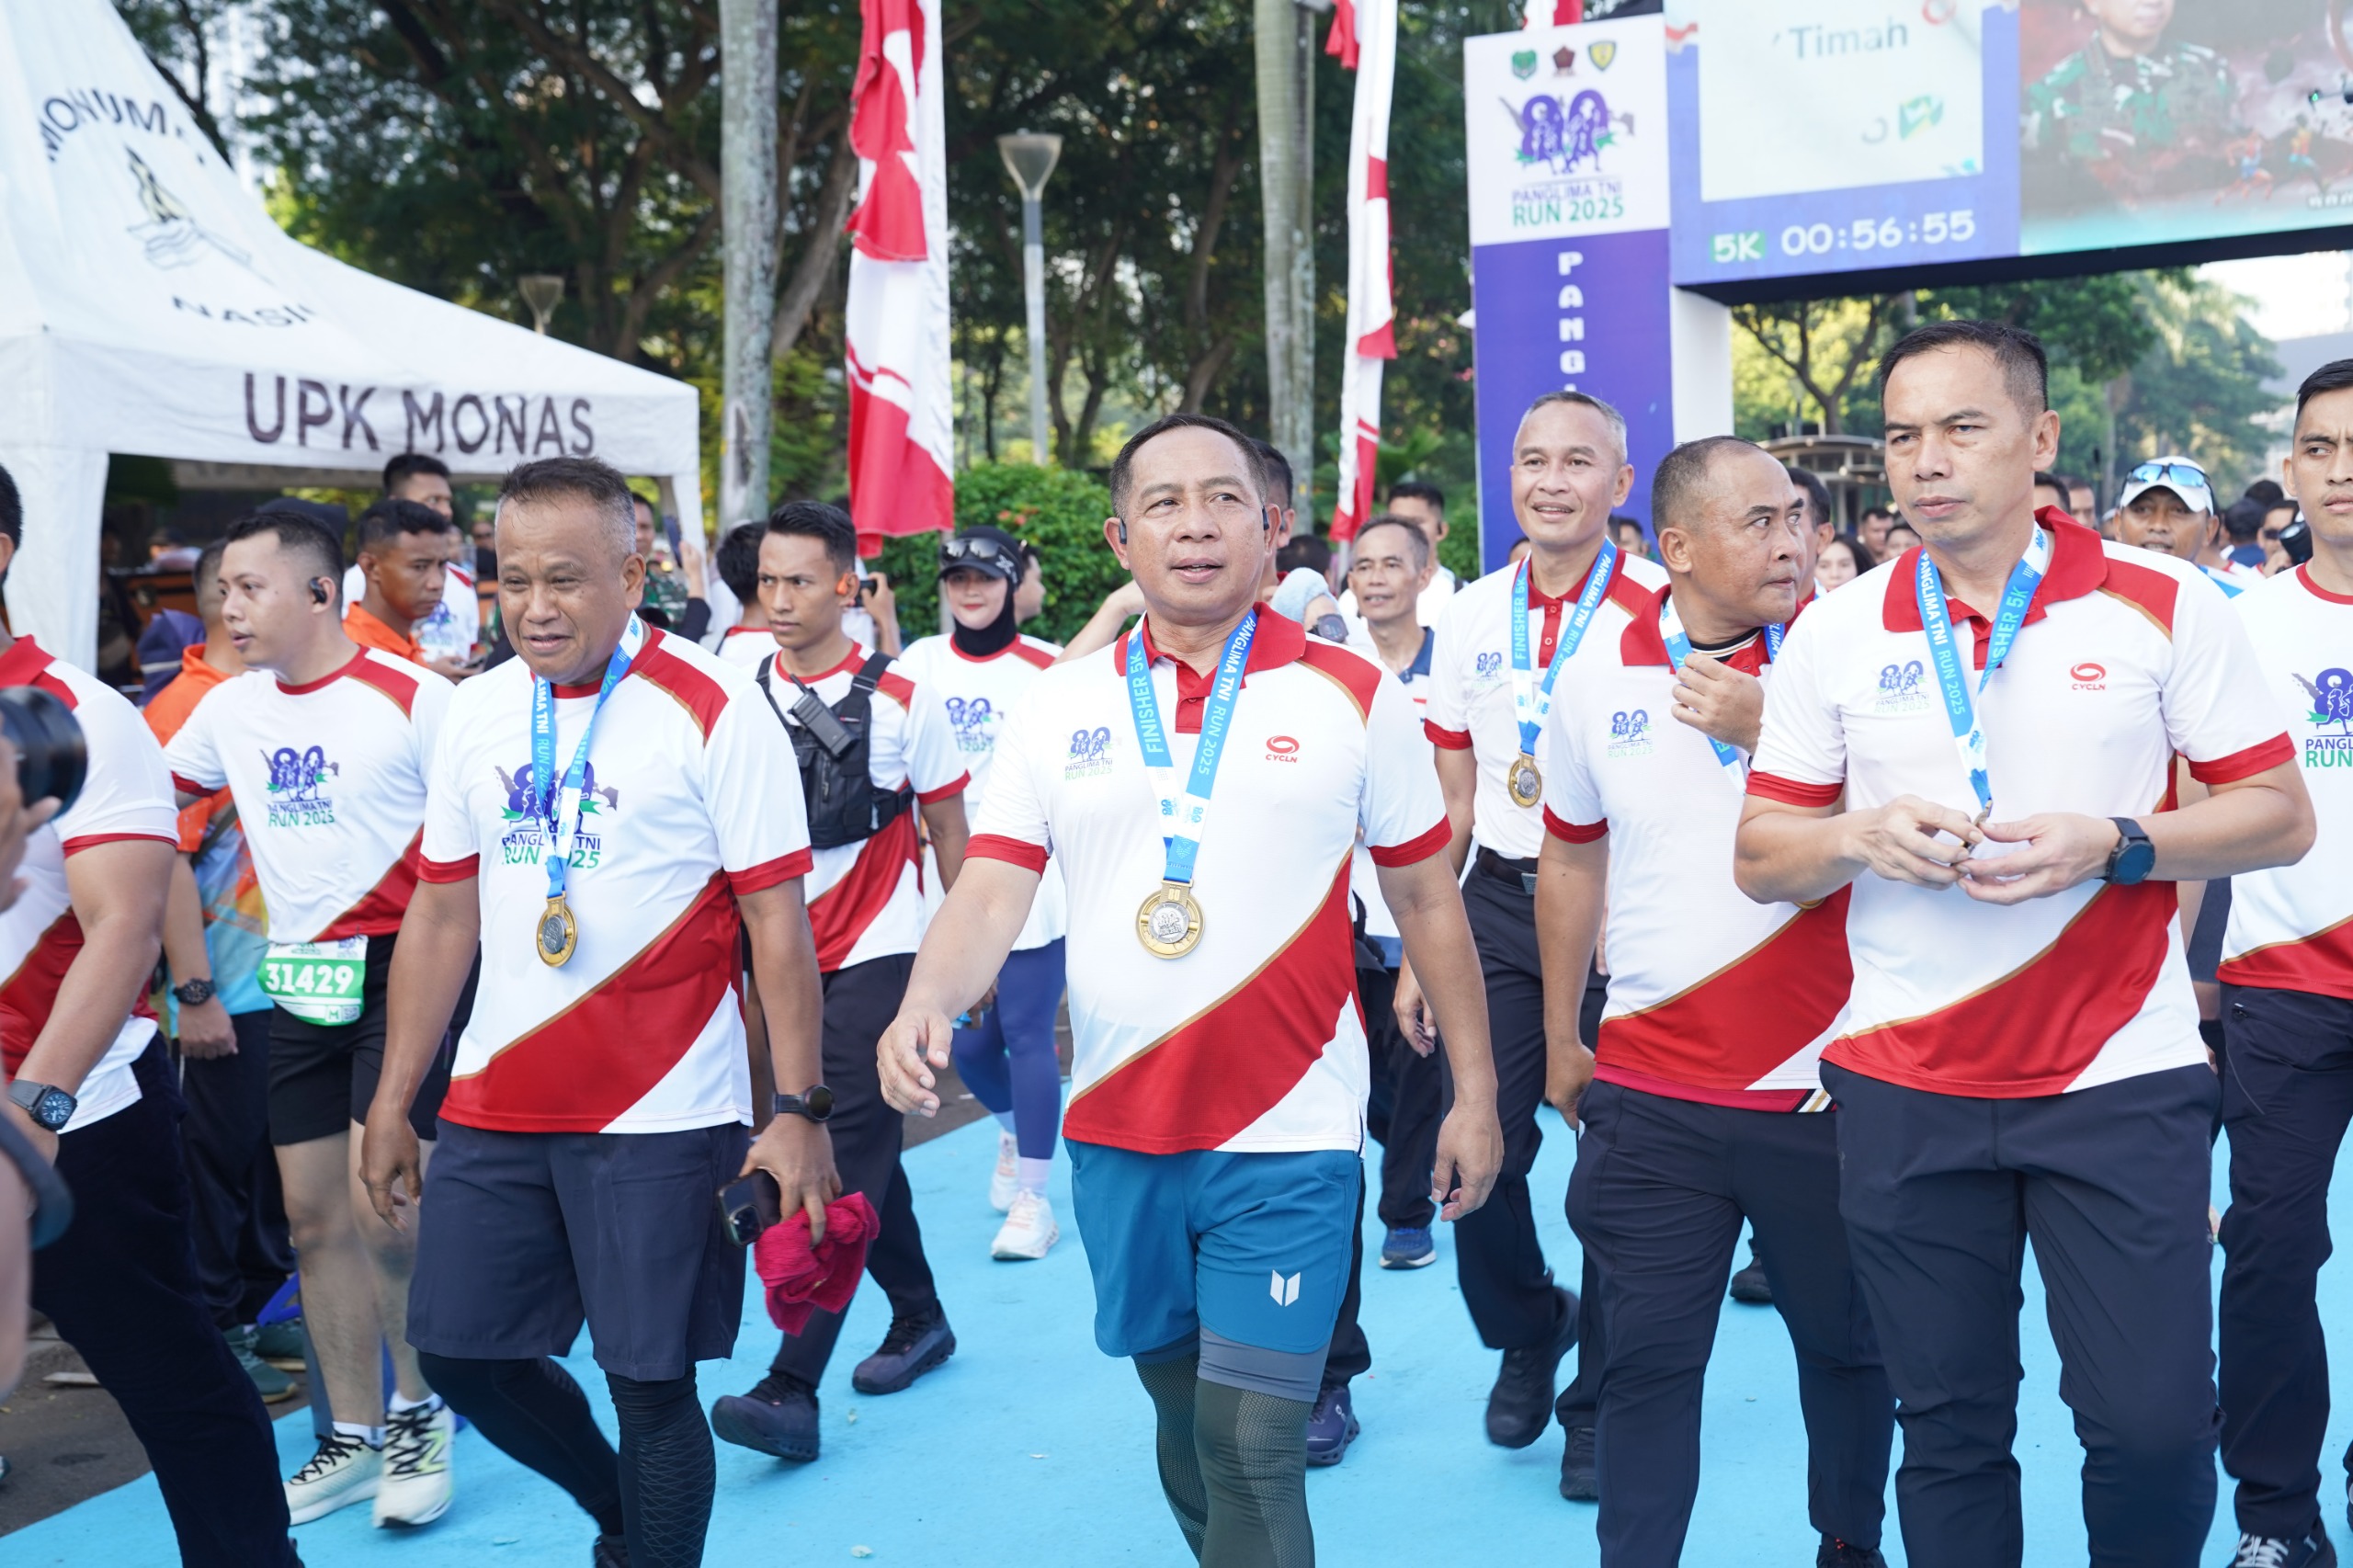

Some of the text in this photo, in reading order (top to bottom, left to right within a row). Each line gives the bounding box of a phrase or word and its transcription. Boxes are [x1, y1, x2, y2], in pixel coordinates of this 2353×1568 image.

[1789, 16, 1909, 59] Timah
[1512, 180, 1622, 203] PANGLIMA TNI
[1513, 195, 1624, 227] RUN 2025
[1713, 210, 1976, 263] 5K 00:56:55
[171, 294, 317, 327] NASI
[1558, 251, 1586, 392] PANG
[244, 371, 595, 457] UPK MONAS
[1583, 553, 1612, 609] PANGLIMA
[2006, 585, 2029, 608] 5K
[1514, 576, 1527, 660] FINISHER 5K
[1574, 608, 1590, 629] TNI
[1565, 629, 1580, 654] RUN
[1920, 553, 1966, 715] PANGLIMA TNI RUN 2025
[1198, 616, 1256, 776] PANGLIMA TNI RUN 2025
[2072, 683, 2106, 691] CYCLN
[1130, 651, 1165, 753] FINISHER 5K
[536, 711, 550, 734] TNI
[537, 738, 551, 765] RUN
[1266, 754, 1298, 763] CYCLN
[2305, 749, 2353, 767] RUN
[1064, 761, 1100, 771] PANGLIMA
[1065, 766, 1112, 780] RUN 2025
[303, 810, 335, 825] 2025
[502, 846, 540, 865] RUN
[575, 835, 601, 851] TNI
[263, 963, 355, 994] 31429
